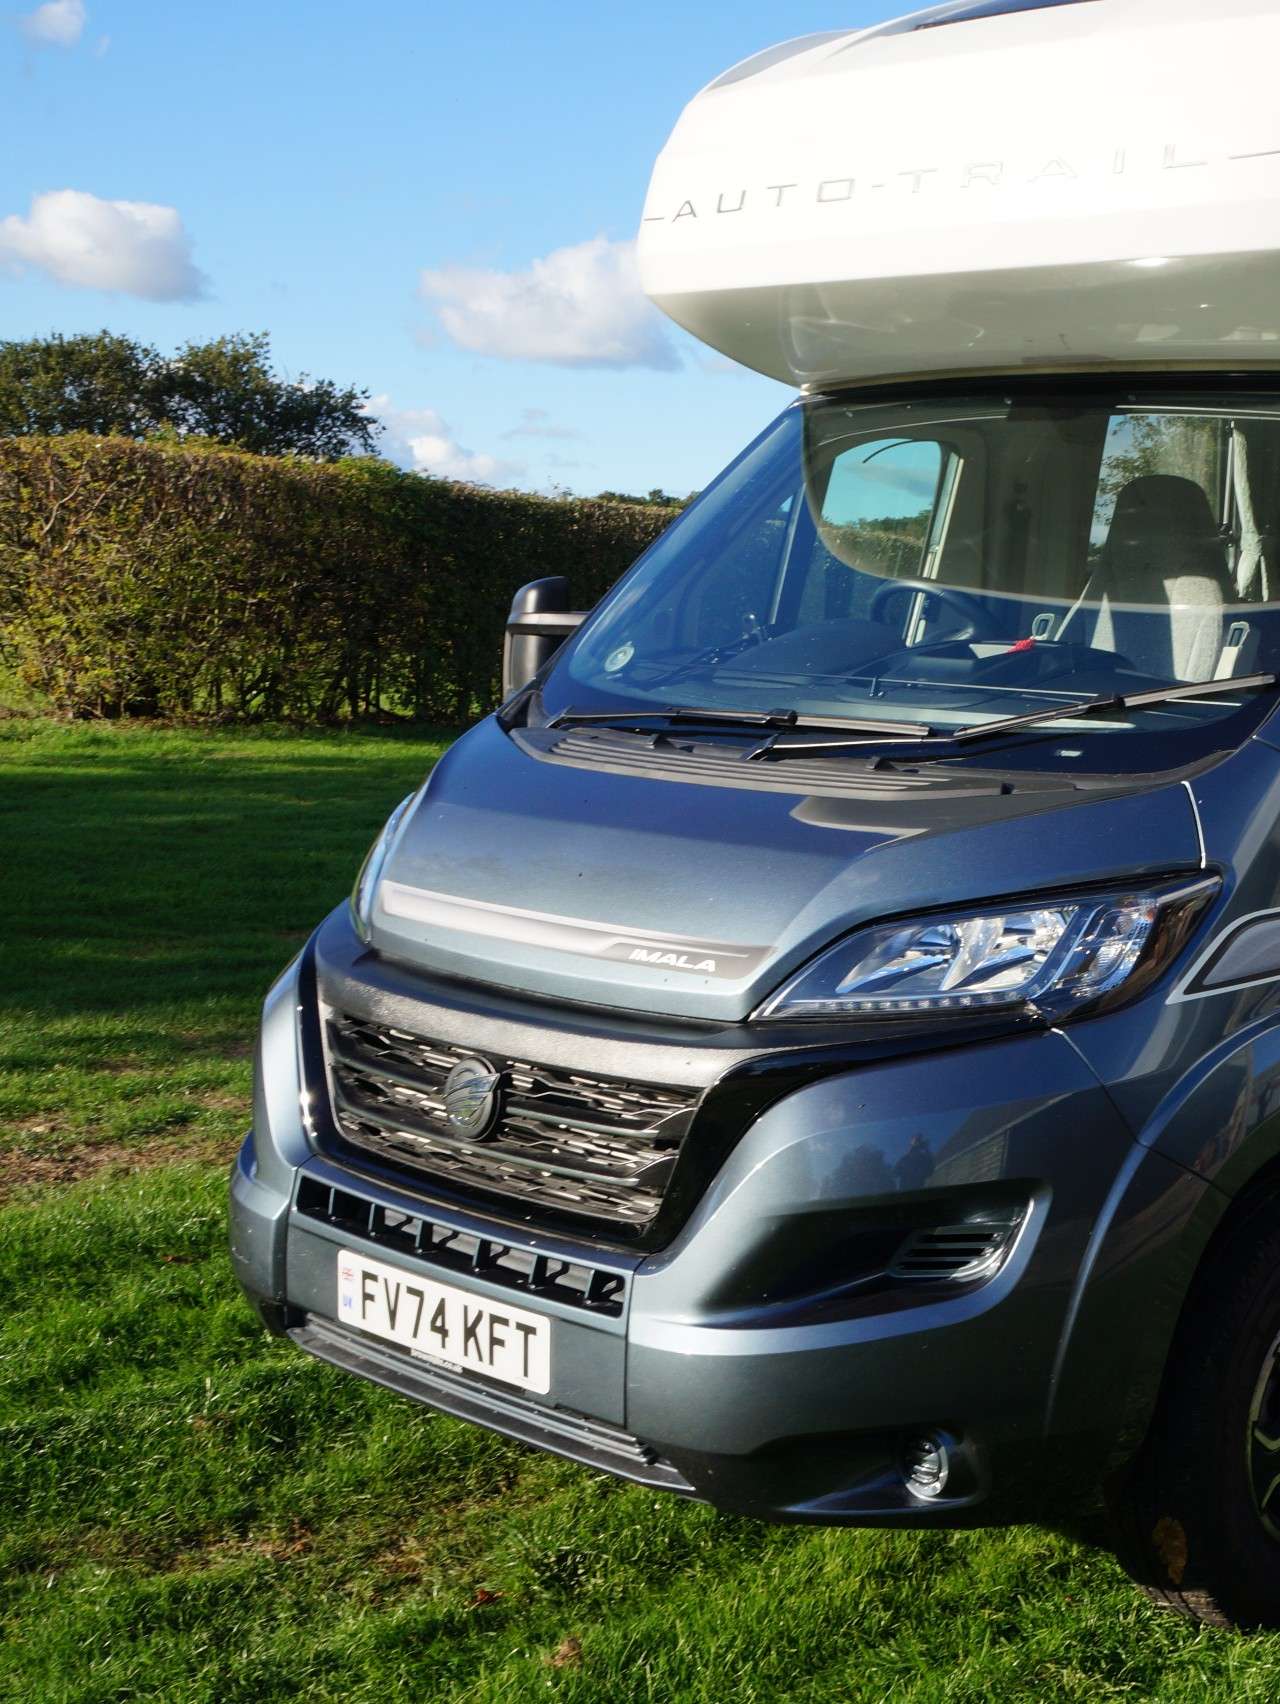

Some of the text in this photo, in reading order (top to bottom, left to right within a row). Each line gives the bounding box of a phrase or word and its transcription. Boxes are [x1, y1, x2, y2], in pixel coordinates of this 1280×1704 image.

[672, 144, 1207, 222] AUTO-TRAIL
[628, 948, 716, 972] IMALA
[362, 1270, 537, 1378] FV74 KFT
